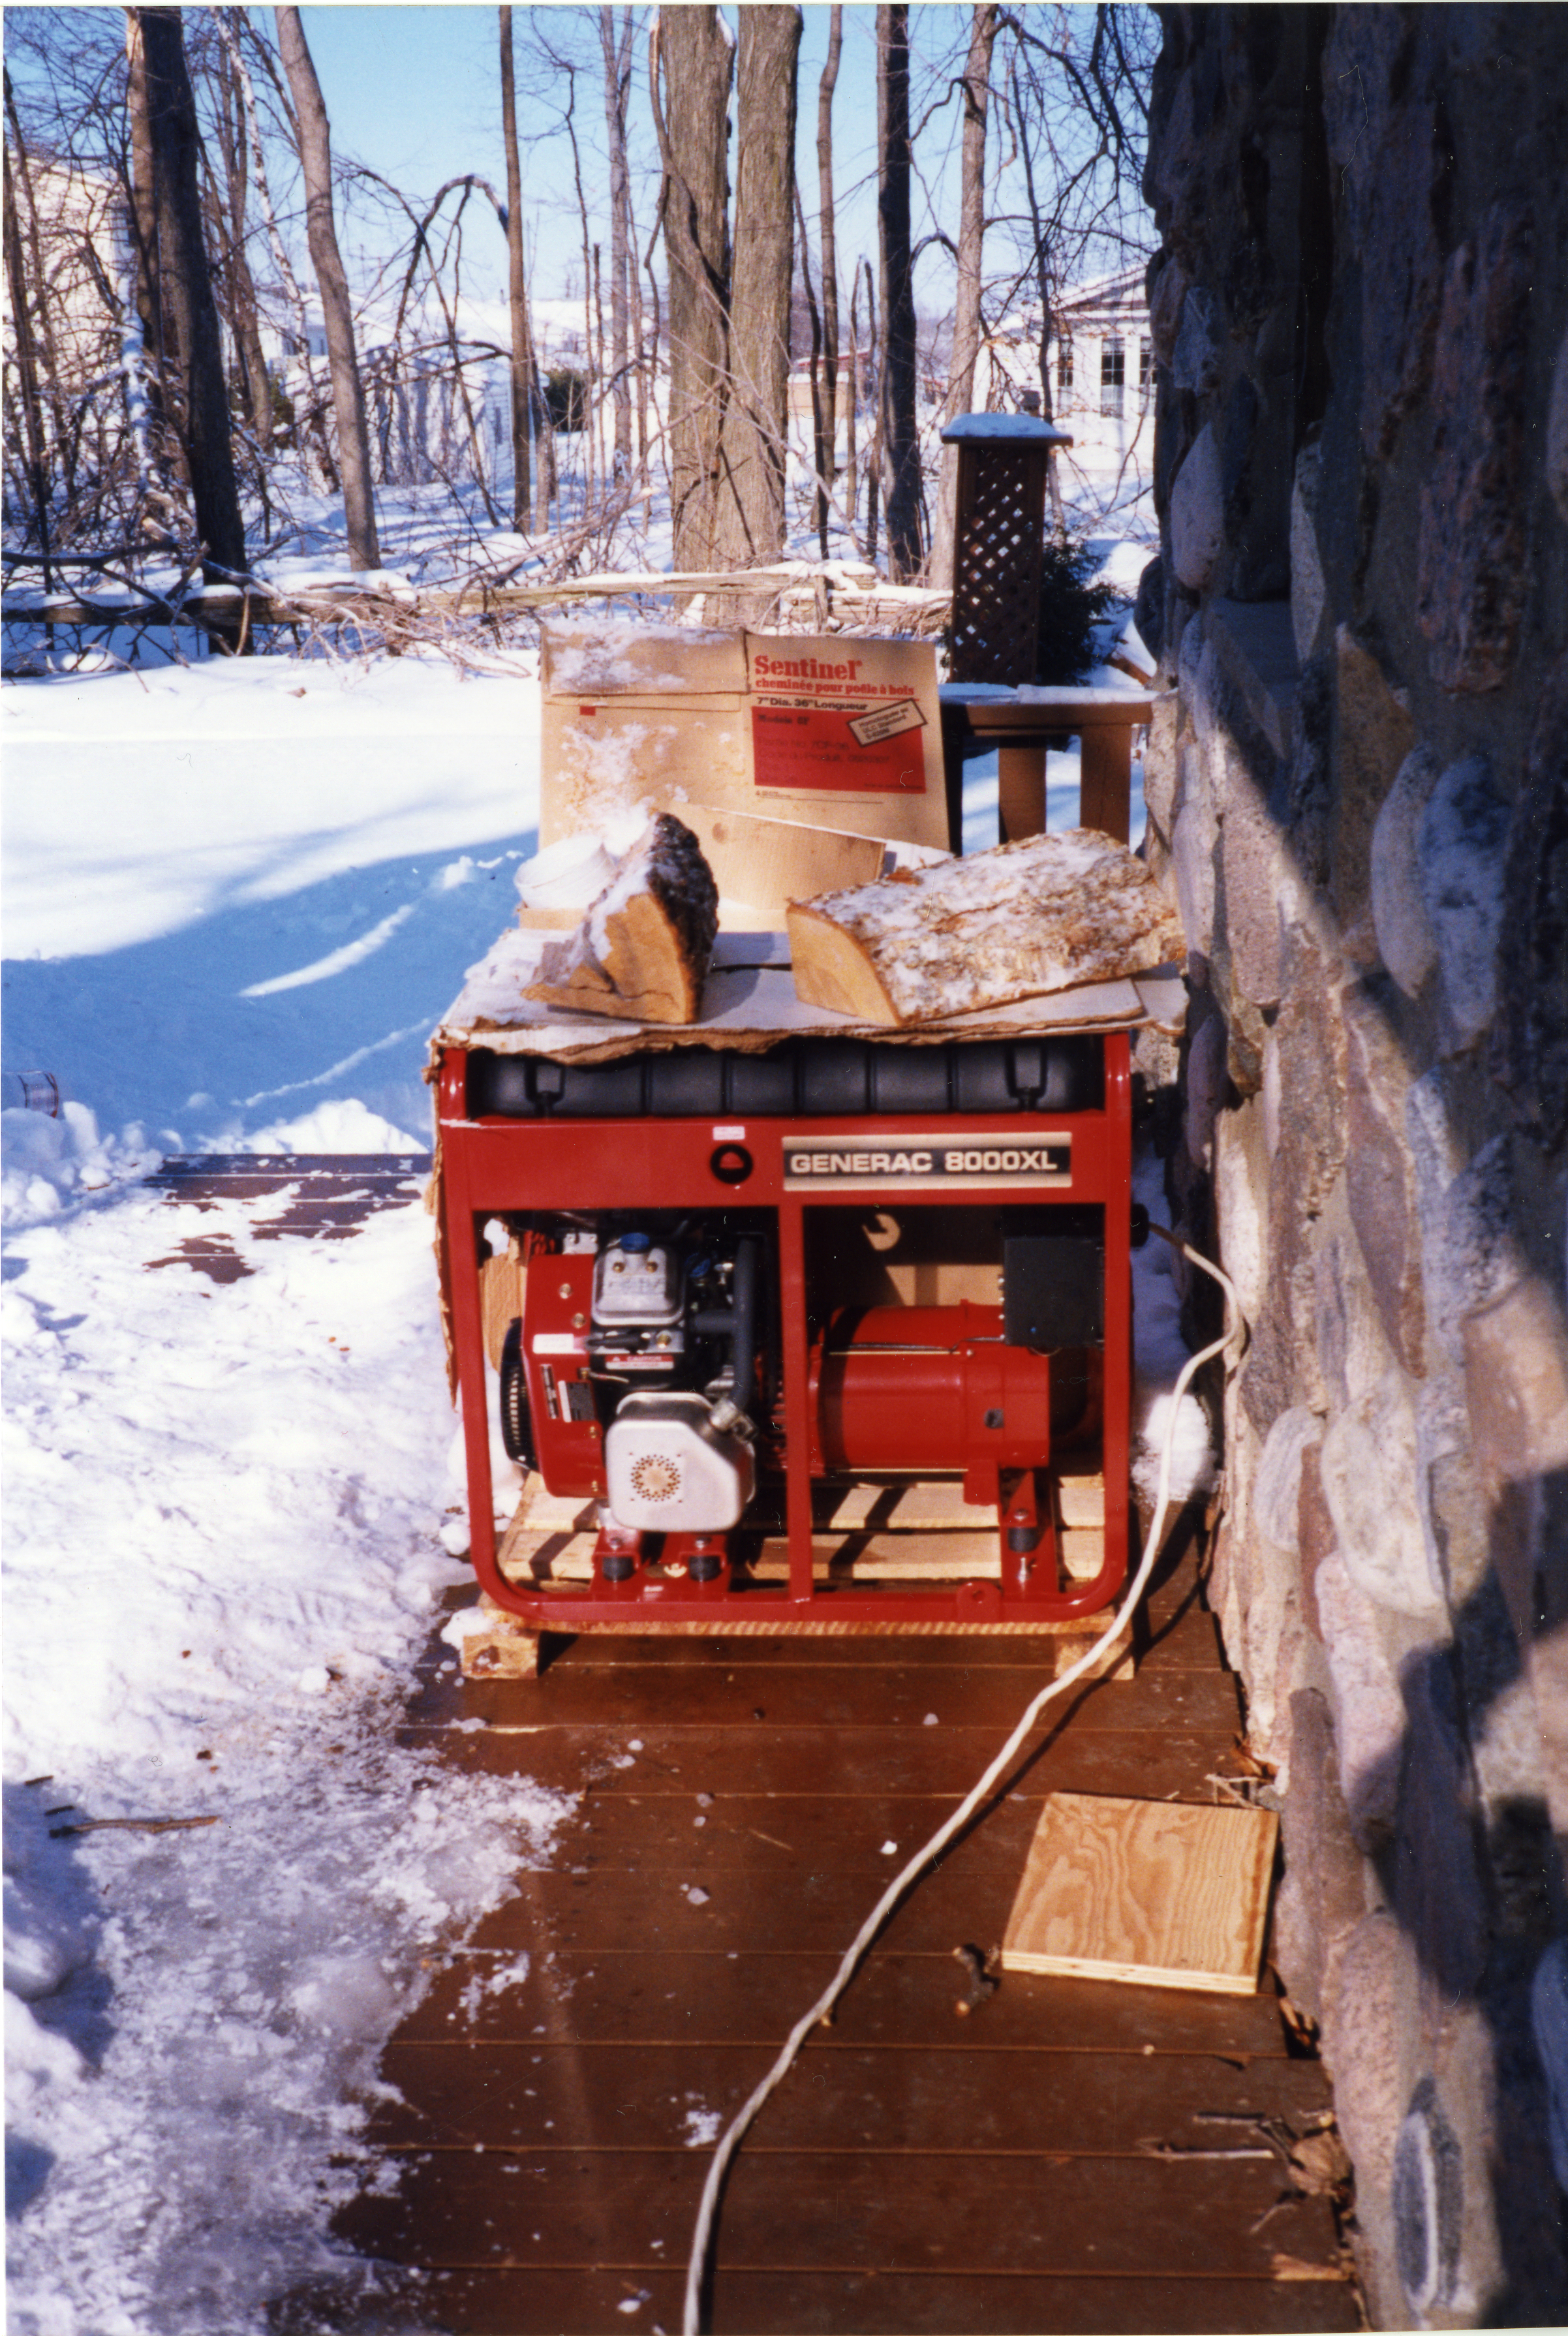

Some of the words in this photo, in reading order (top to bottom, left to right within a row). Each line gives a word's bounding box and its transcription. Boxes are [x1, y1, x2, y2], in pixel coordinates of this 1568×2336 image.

[755, 678, 814, 692] cheminée
[815, 683, 843, 694] pour
[880, 684, 887, 695] à
[889, 684, 915, 696] bois
[770, 698, 792, 707] Dia.
[815, 699, 869, 711] Longueur
[790, 1152, 933, 1173] GENERAC
[944, 1150, 1058, 1171] 8000XL
